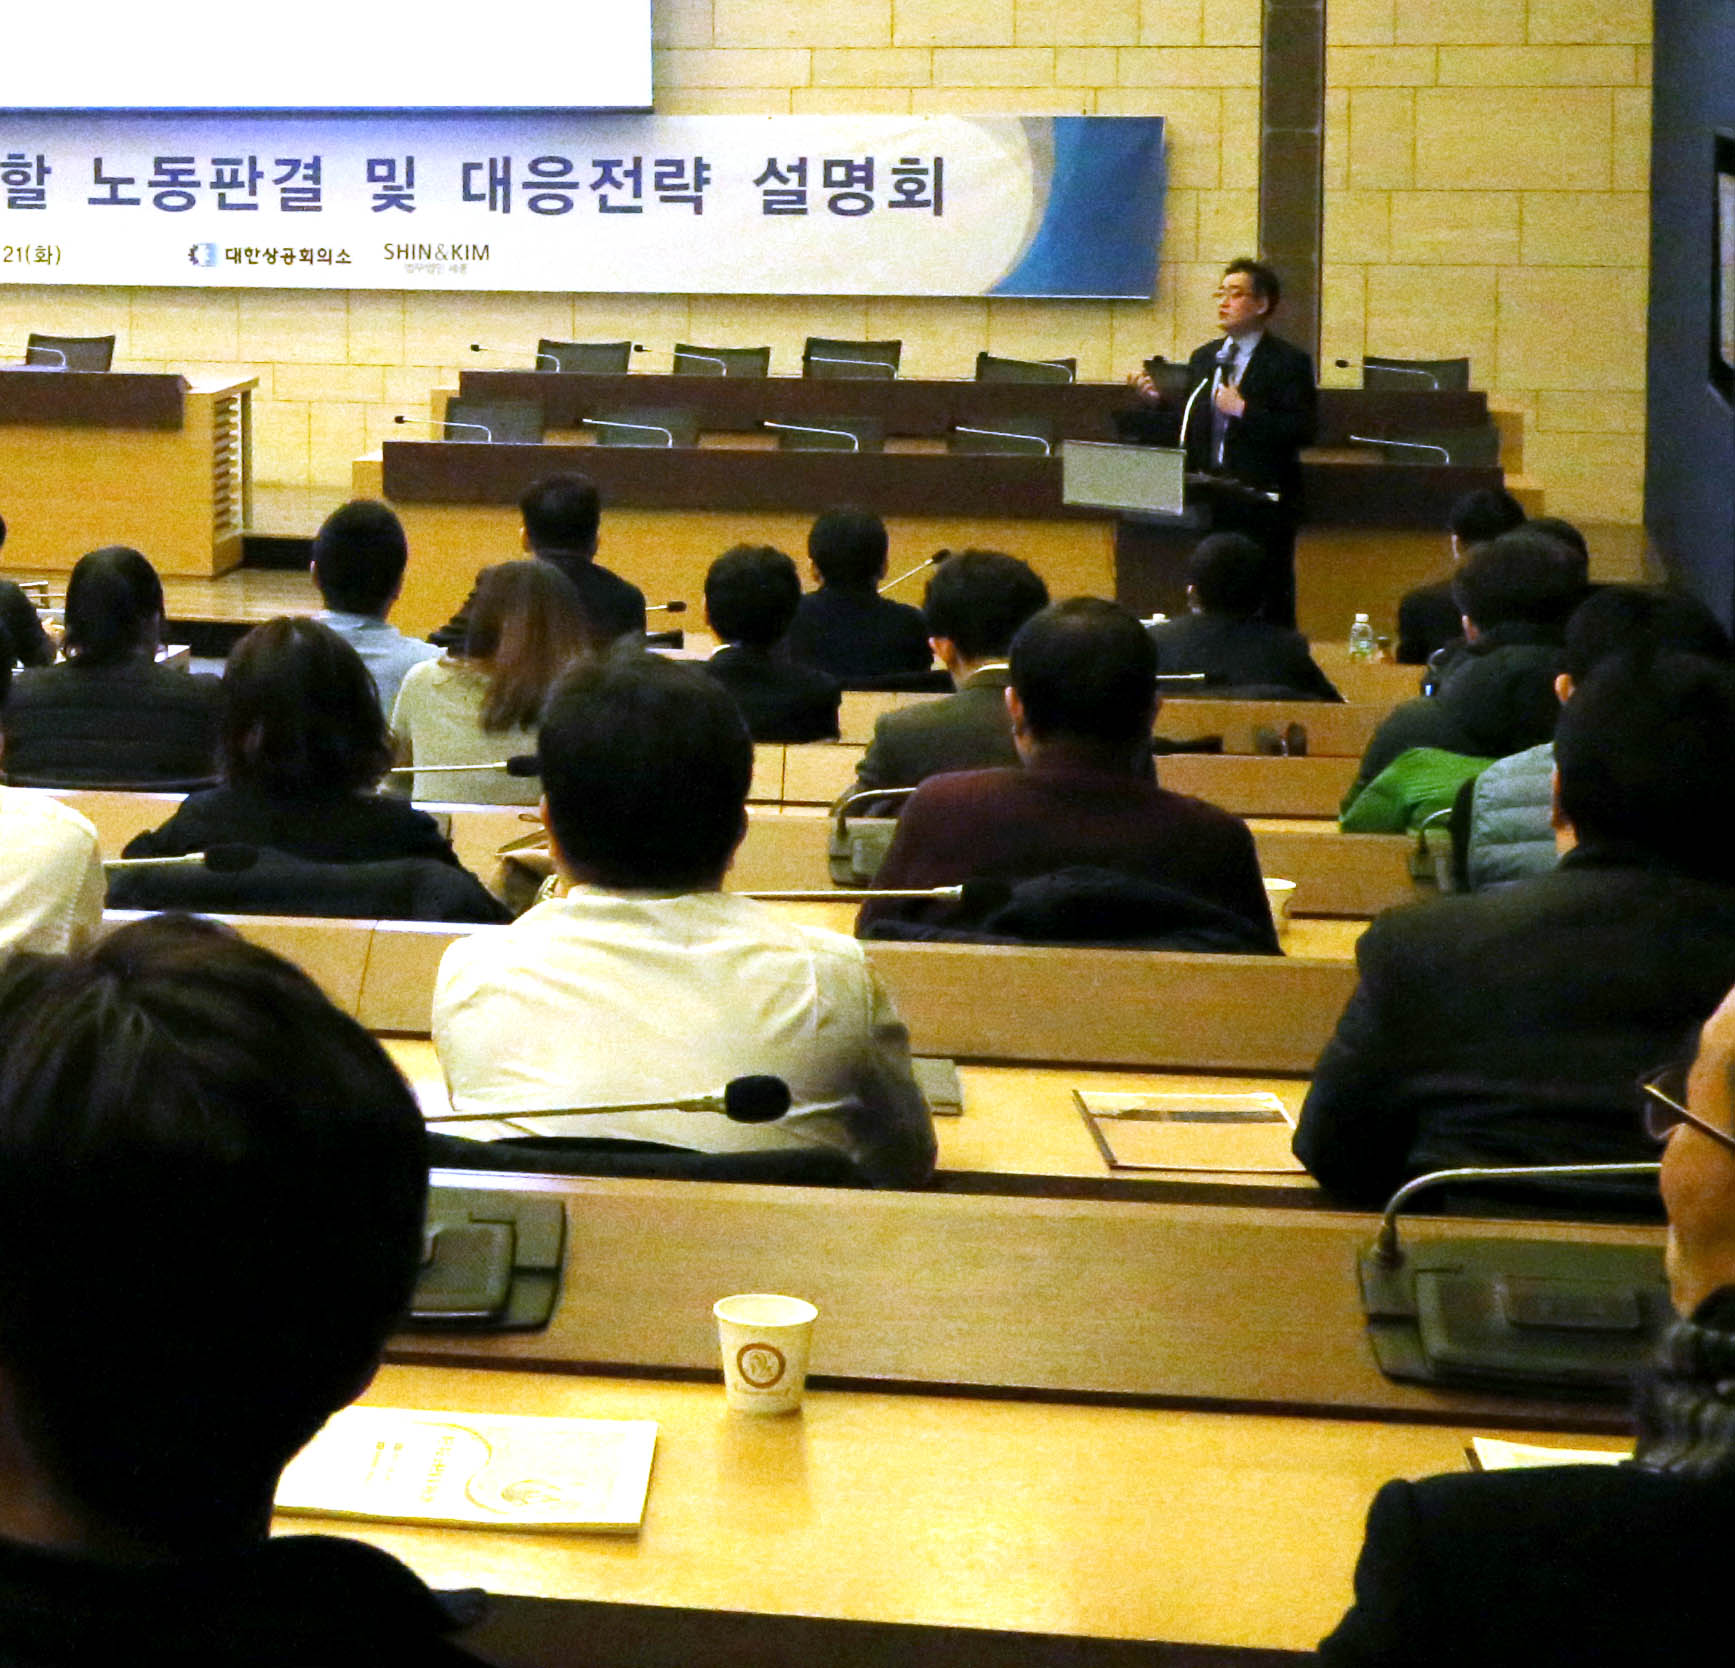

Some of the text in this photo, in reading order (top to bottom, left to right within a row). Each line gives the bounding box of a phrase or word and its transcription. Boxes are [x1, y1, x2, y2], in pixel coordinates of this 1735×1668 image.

[0, 153, 52, 210] 할
[87, 155, 322, 212] 노동판결
[366, 155, 416, 213] 및
[462, 155, 711, 216] 대응전략
[753, 156, 944, 217] 설명회
[3, 244, 61, 266] 21(화)
[225, 246, 352, 266] 대한상공회의소
[383, 242, 490, 261] SHIN&KIM
